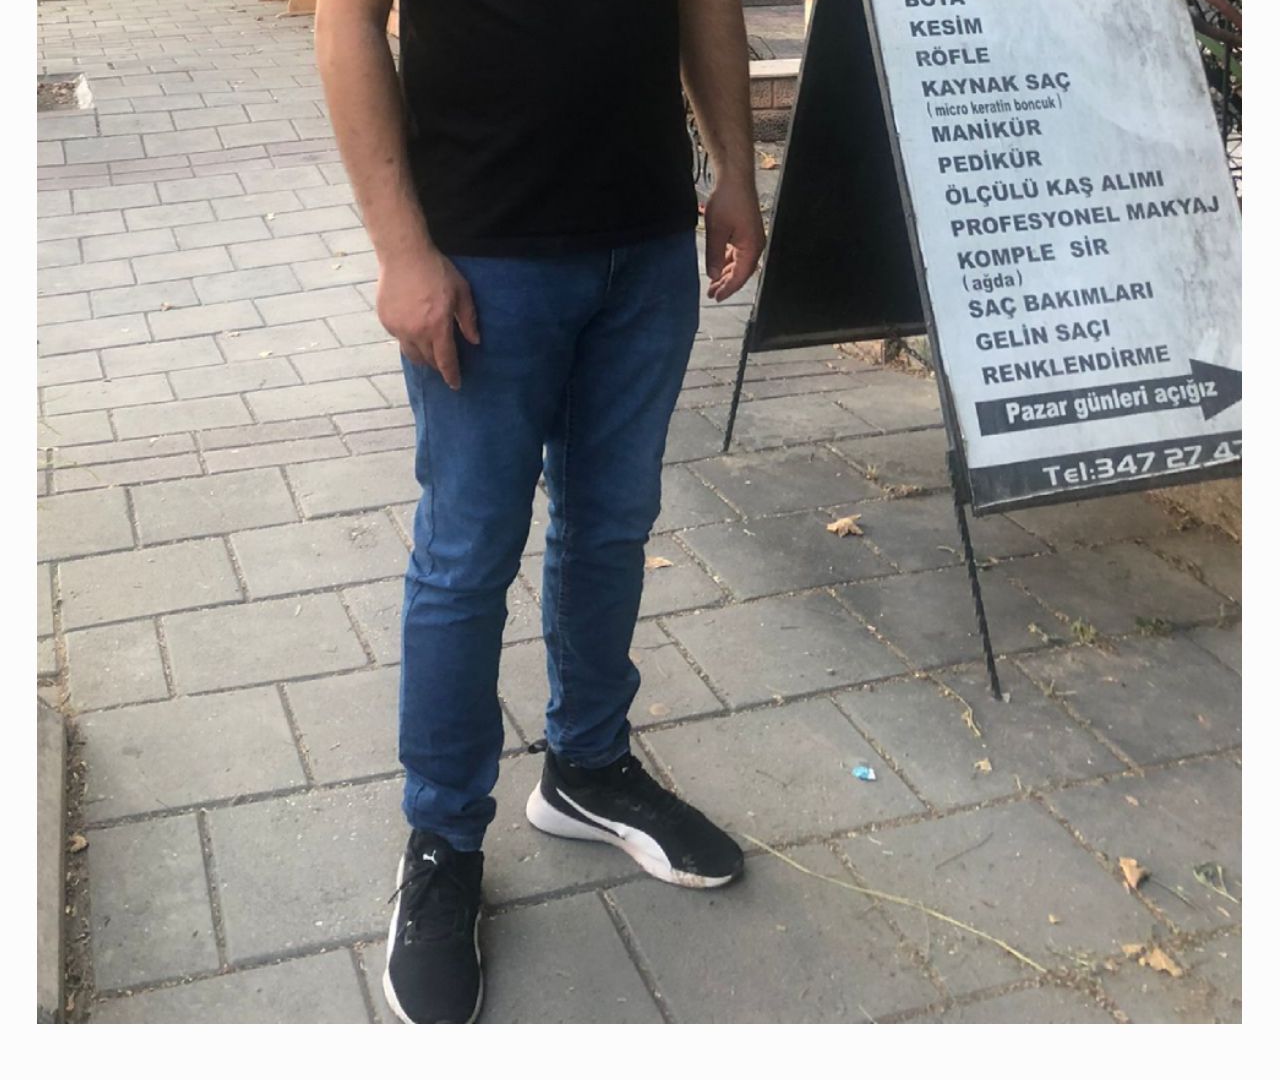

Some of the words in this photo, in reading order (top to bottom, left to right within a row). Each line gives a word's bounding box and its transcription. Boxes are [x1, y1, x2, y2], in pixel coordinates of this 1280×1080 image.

[910, 15, 983, 37] KESİM
[915, 46, 991, 67] RÖFLE
[921, 76, 1020, 97] KAYNAK
[1025, 72, 1071, 91] SAÇ
[970, 100, 1012, 115] keratin
[931, 117, 1043, 143] MANİKÜR
[938, 149, 1043, 174] PEDİKÜR
[945, 178, 1040, 207] ÖLÇÜLÜ
[1046, 176, 1094, 198] KAŞ
[1101, 170, 1165, 192] ALIMI
[950, 205, 1121, 237] PROFESYONEL
[1126, 195, 1220, 221] MAKYAJ
[957, 243, 1056, 269] KOMPLE
[1070, 235, 1110, 258] SİR
[968, 297, 1017, 320] SAÇ
[1024, 281, 1154, 313] BAKIMLARI
[975, 323, 1049, 351] GELİN
[1055, 319, 1111, 342] SAÇI
[981, 344, 1172, 385] RENKLENDİRME
[1006, 400, 1068, 424] Pazar
[1074, 385, 1149, 419] günleri
[1155, 379, 1219, 407] açığız
[1042, 452, 1156, 486] Tel:347
[1164, 445, 1202, 469] 27
